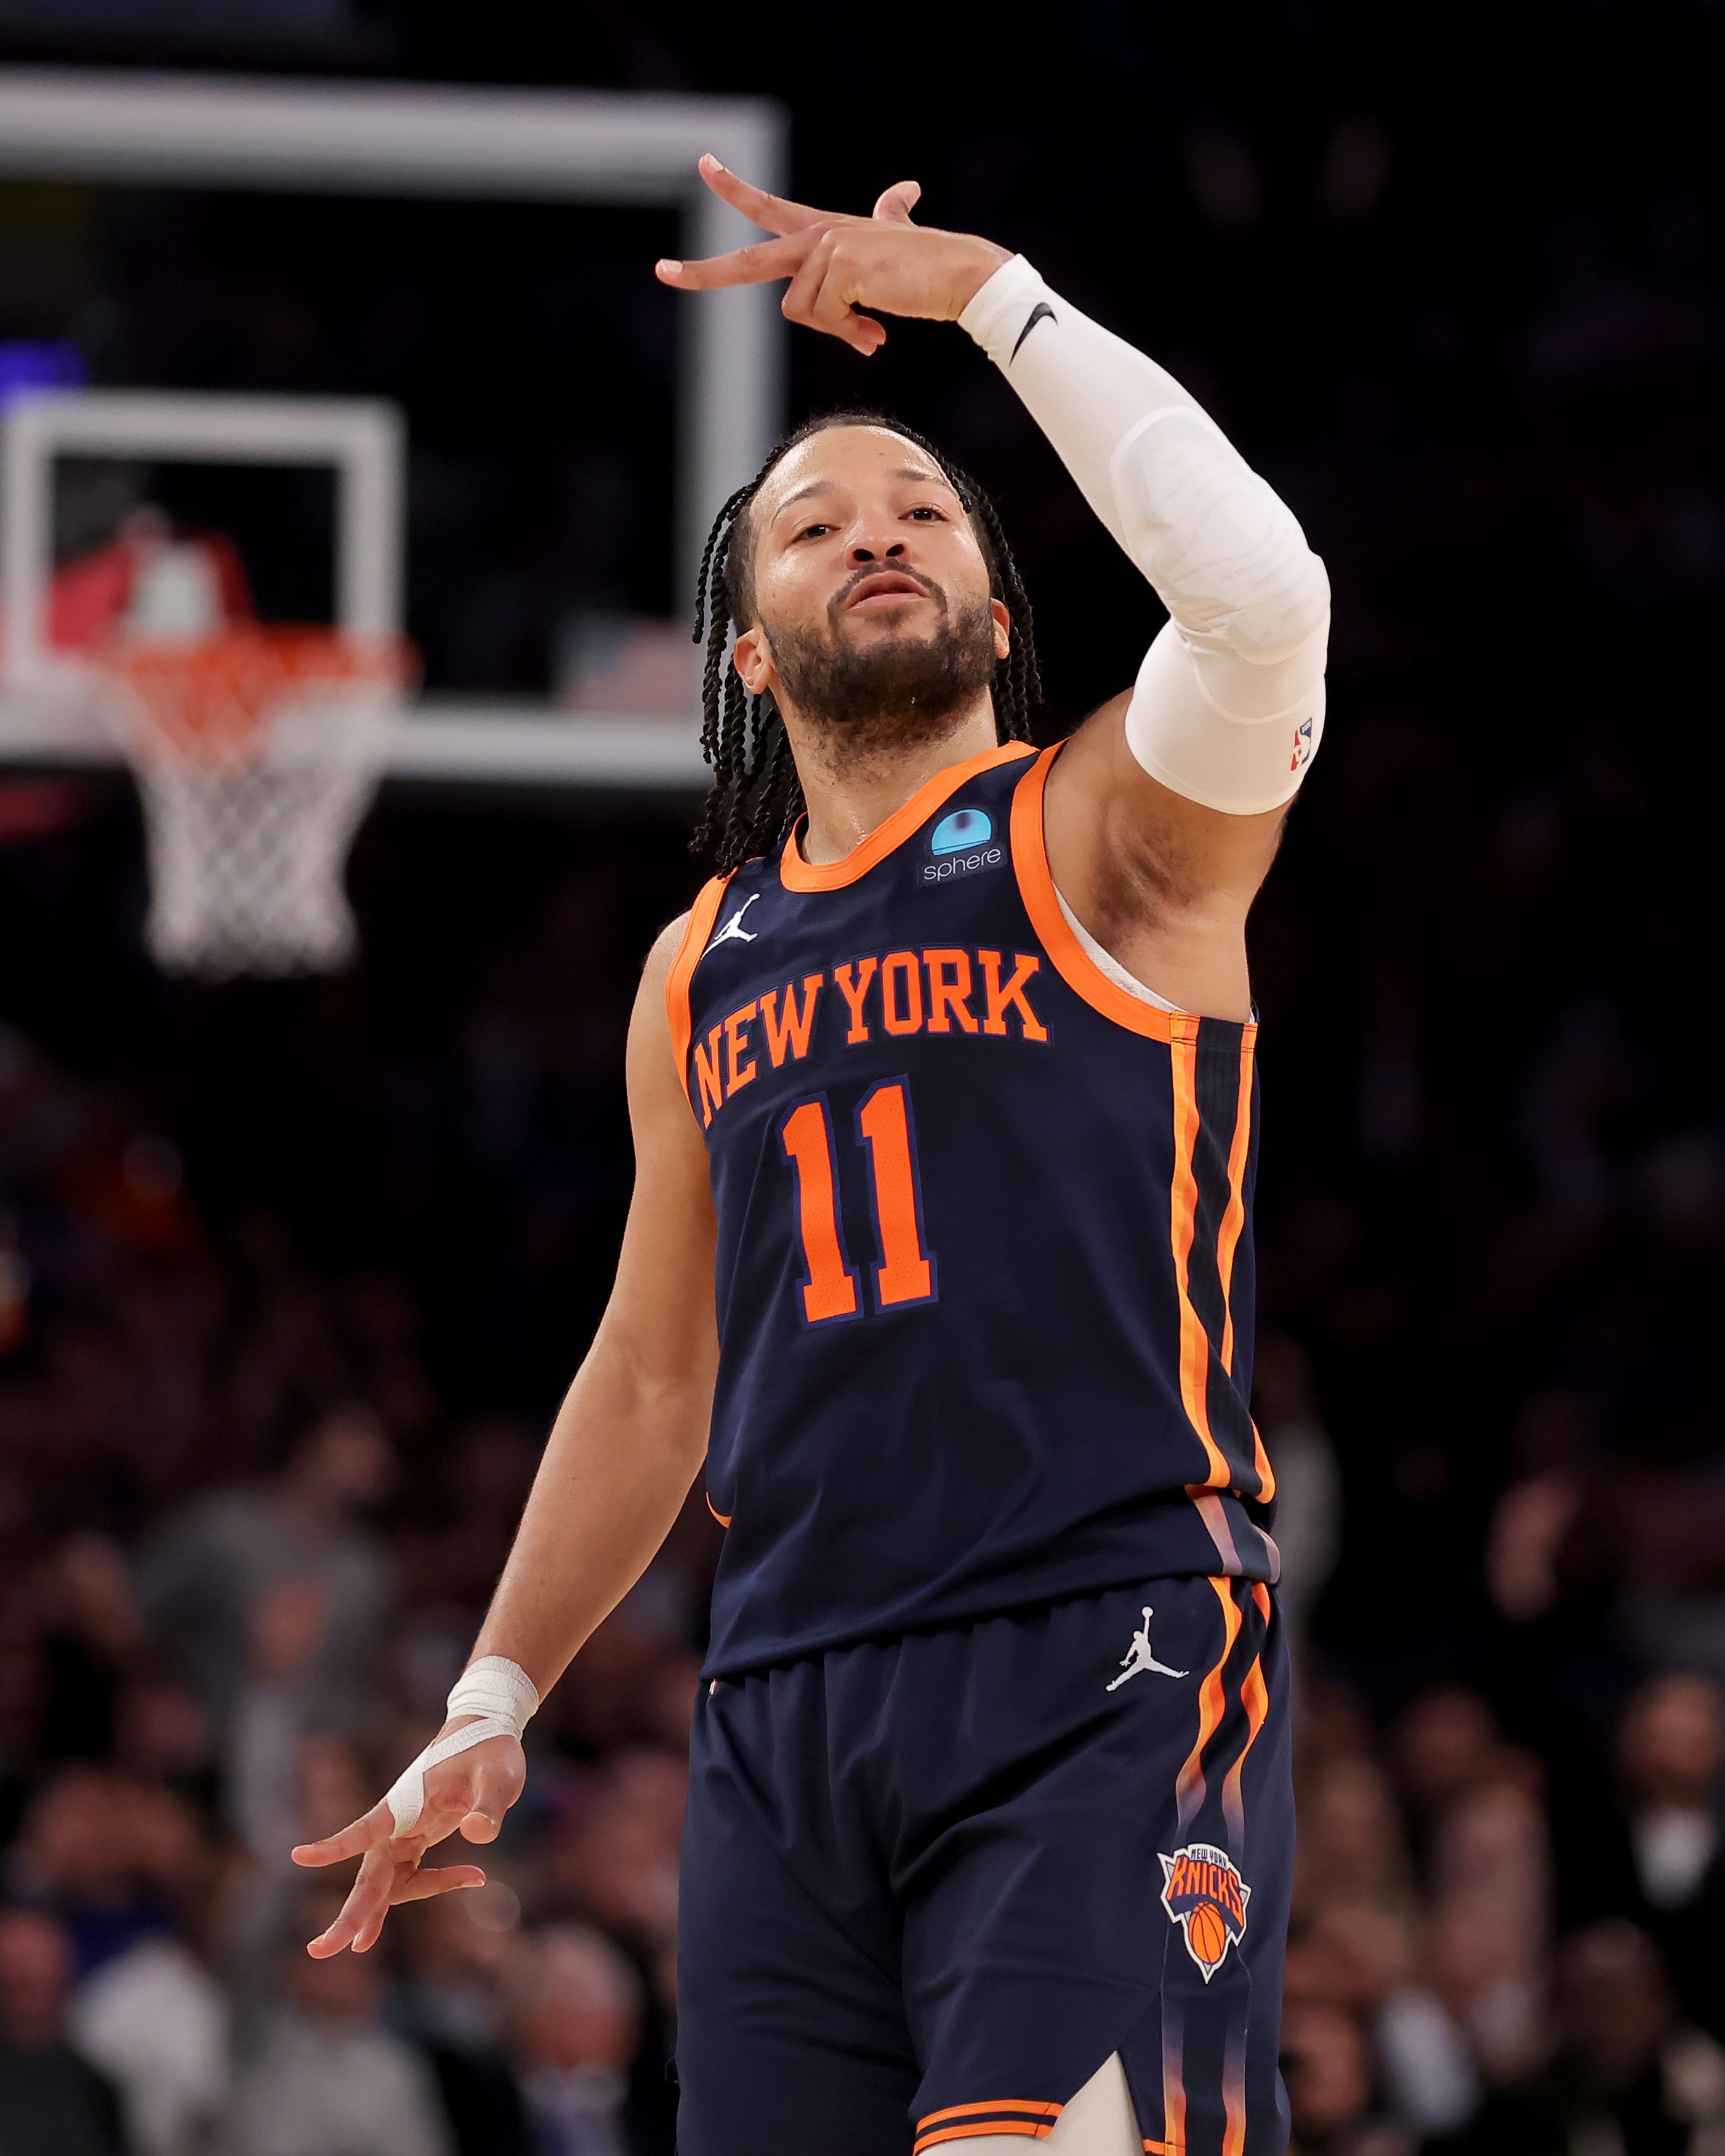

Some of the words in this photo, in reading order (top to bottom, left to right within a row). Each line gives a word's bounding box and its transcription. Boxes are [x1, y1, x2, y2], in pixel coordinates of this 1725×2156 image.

[923, 848, 1001, 881] sphere
[694, 972, 823, 1130] NEW
[834, 948, 1048, 1046] YORK
[778, 1078, 935, 1327] 11
[1167, 1856, 1244, 1928] KNICKS
[1191, 1848, 1208, 1860] NEW
[1209, 1849, 1228, 1871] YORK
